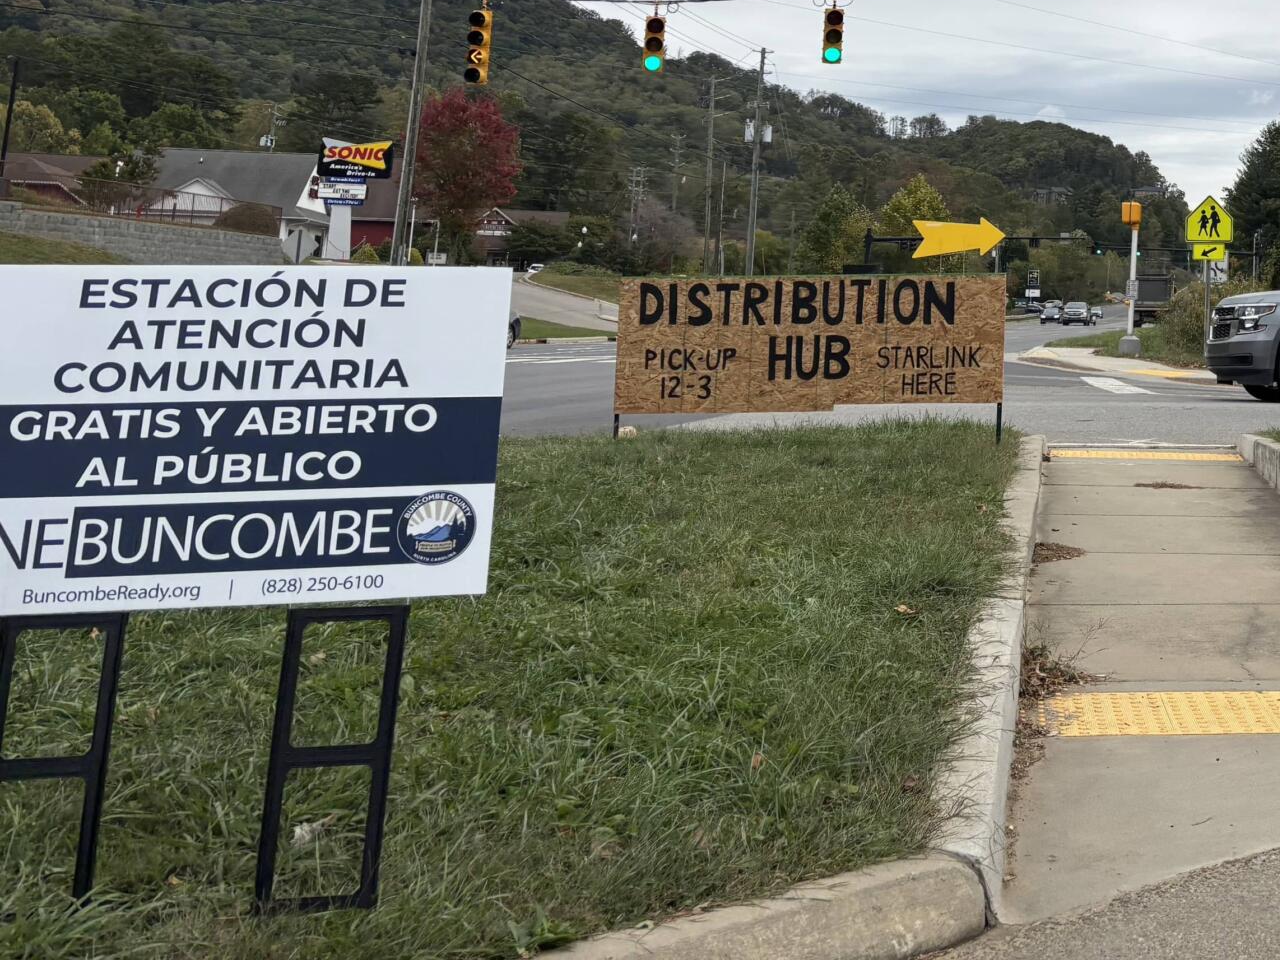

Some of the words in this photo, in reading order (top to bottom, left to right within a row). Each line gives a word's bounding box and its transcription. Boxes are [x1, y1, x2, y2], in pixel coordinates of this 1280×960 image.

[327, 146, 386, 161] SONIC
[78, 271, 327, 309] ESTACIÓN
[343, 278, 407, 308] DE
[639, 279, 956, 326] DISTRIBUTION
[107, 311, 367, 350] ATENCIÓN
[644, 347, 737, 371] PICK-UP
[767, 335, 851, 381] HUB
[876, 345, 982, 369] STARLINK
[53, 358, 409, 394] COMUNITARIA
[660, 375, 712, 400] 12-3
[900, 372, 956, 396] HERE
[8, 407, 182, 442] GRATIS
[195, 407, 227, 437] Y
[235, 403, 438, 436] ABIERTO
[75, 456, 139, 488] AL
[153, 446, 362, 486] PÚBLICO
[404, 492, 446, 519] BUNCOMBE
[446, 493, 472, 517] COUNTY
[22, 585, 201, 605] BuncombeReady.org
[261, 576, 303, 597] (828)
[306, 574, 384, 593] 250-6100
